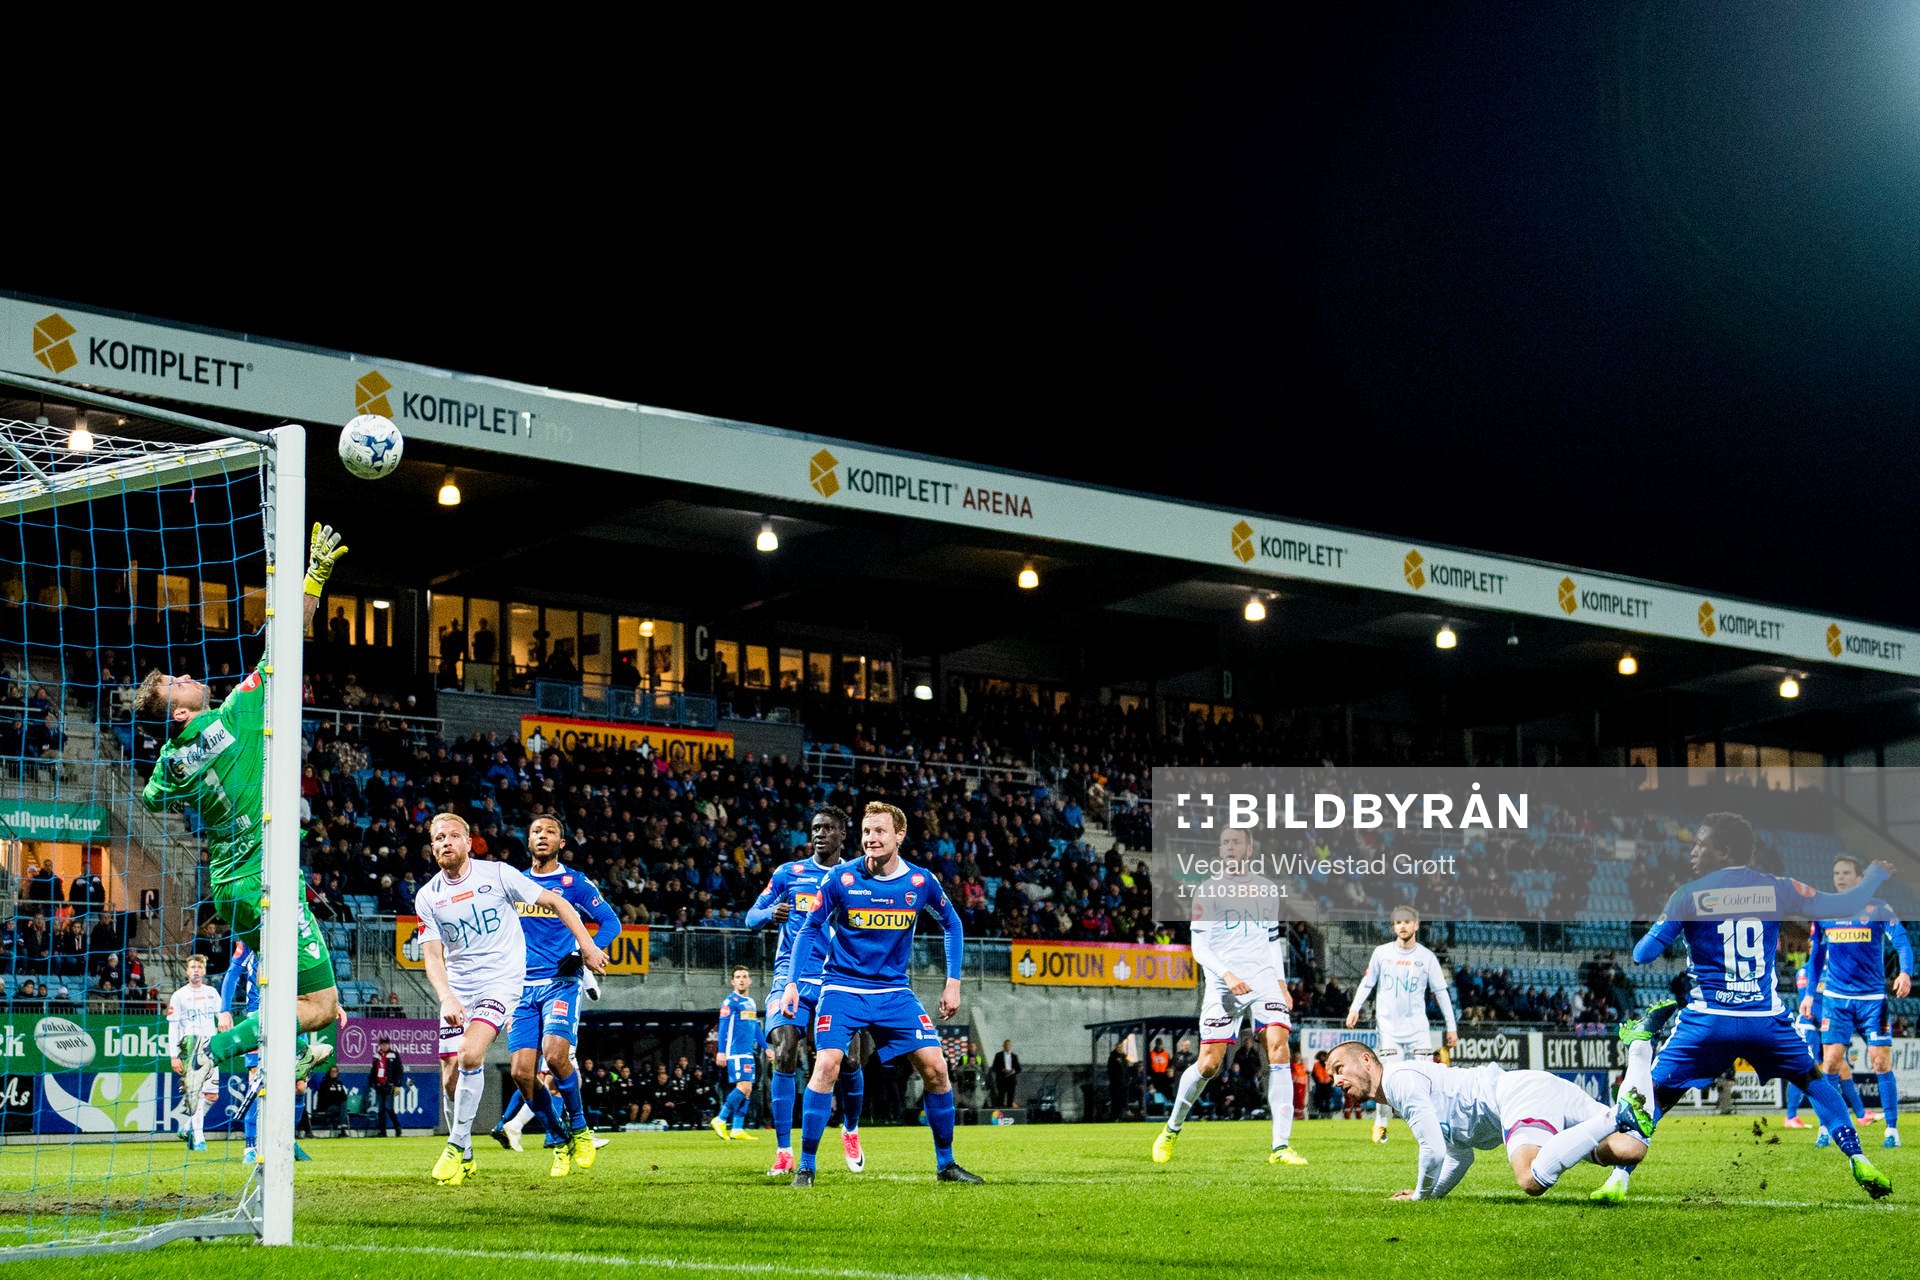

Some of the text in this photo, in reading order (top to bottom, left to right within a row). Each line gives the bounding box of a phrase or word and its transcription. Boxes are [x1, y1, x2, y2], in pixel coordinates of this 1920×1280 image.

[962, 486, 1034, 520] ARENA
[441, 903, 501, 948] DNB
[866, 914, 914, 927] JOTUN
[1717, 917, 1766, 981] 19
[1039, 951, 1104, 977] JOTUN
[1134, 954, 1193, 980] JOTUN
[1547, 1039, 1578, 1068] EKTE
[1580, 1039, 1611, 1067] VARE
